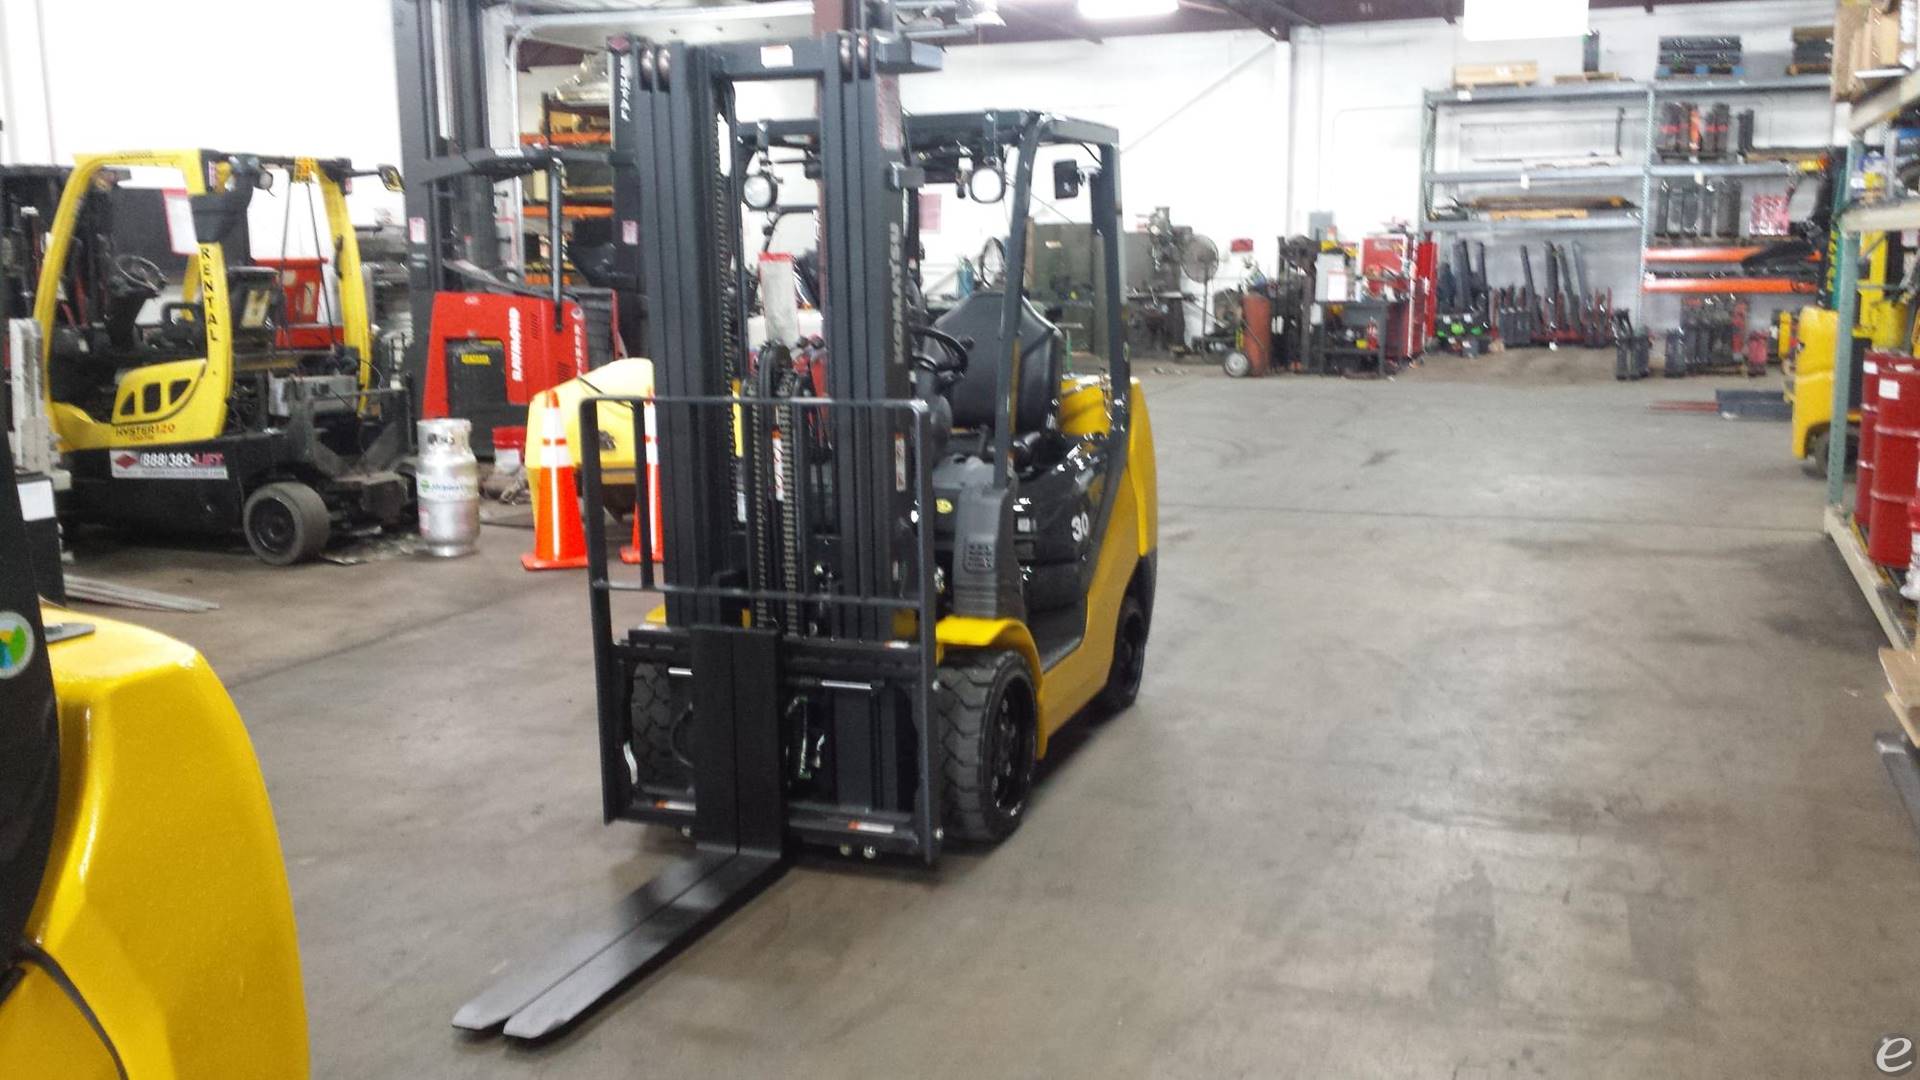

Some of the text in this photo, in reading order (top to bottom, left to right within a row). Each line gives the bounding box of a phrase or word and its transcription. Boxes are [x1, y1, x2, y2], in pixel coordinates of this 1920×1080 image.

[200, 247, 219, 342] RENTAL
[888, 221, 904, 364] KOMATSU
[1071, 511, 1089, 542] 30
